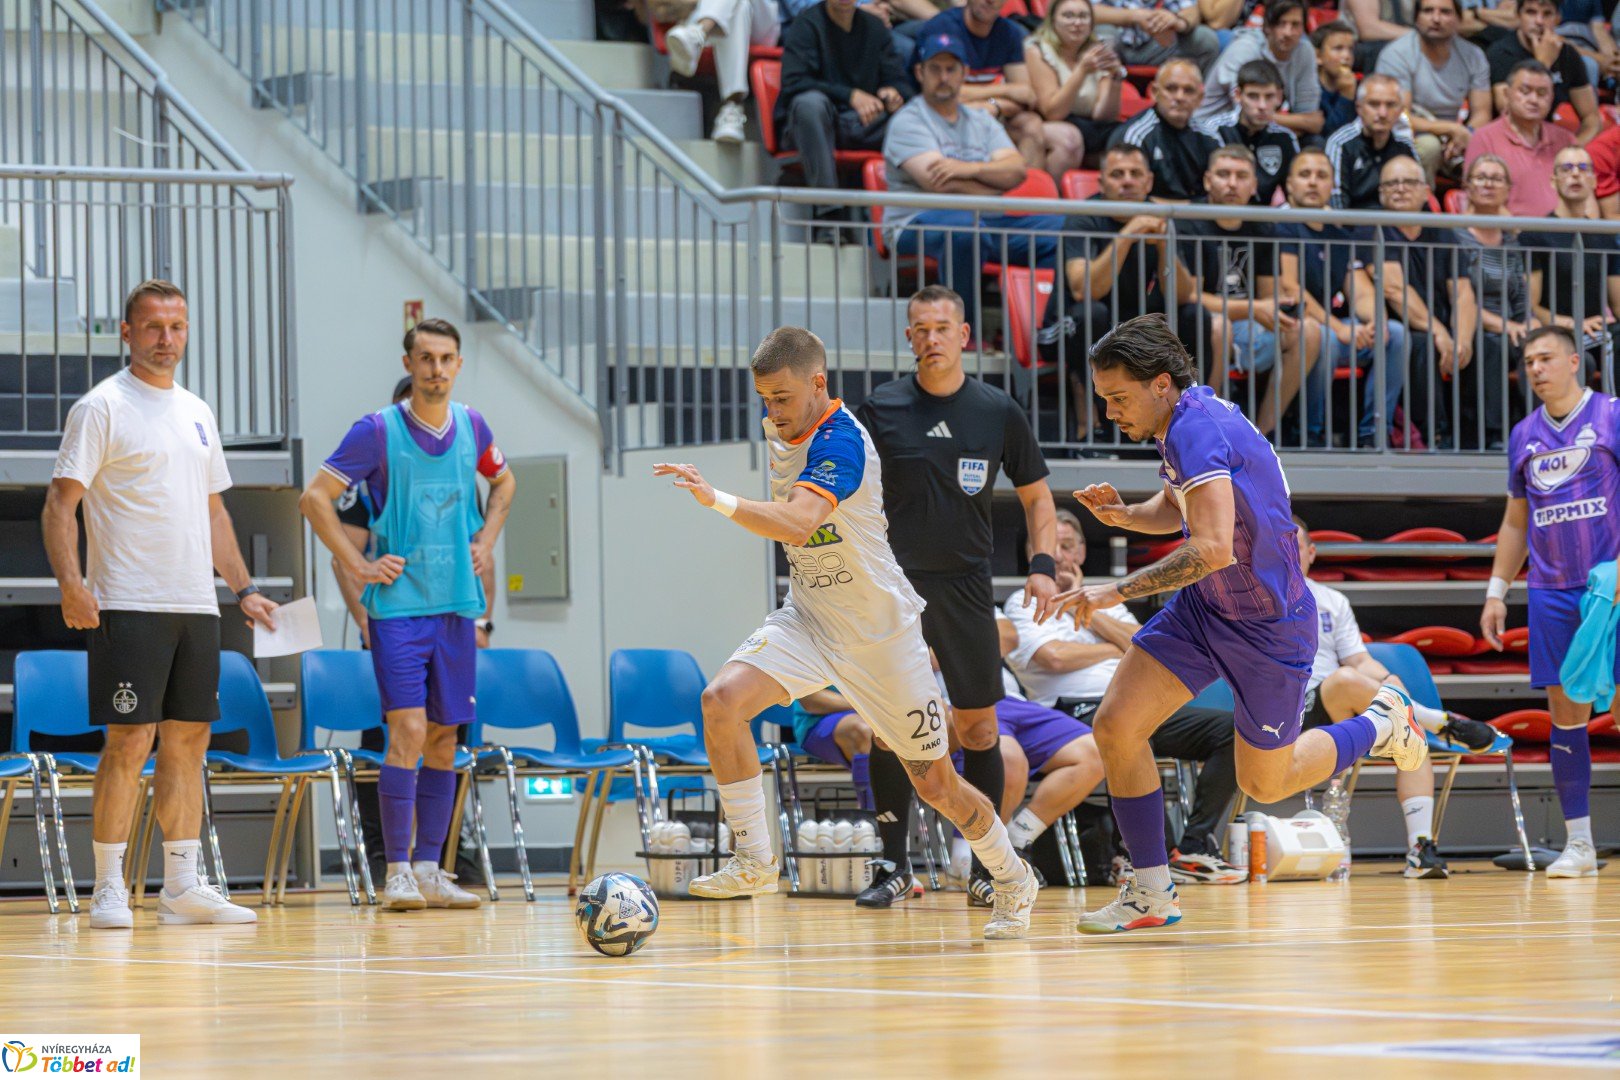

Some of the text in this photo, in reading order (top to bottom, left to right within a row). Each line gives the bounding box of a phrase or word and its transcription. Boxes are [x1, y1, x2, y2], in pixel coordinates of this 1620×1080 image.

[961, 461, 985, 471] FIFA
[1538, 456, 1568, 474] MOL
[906, 699, 942, 739] 28
[920, 737, 942, 751] JAKO
